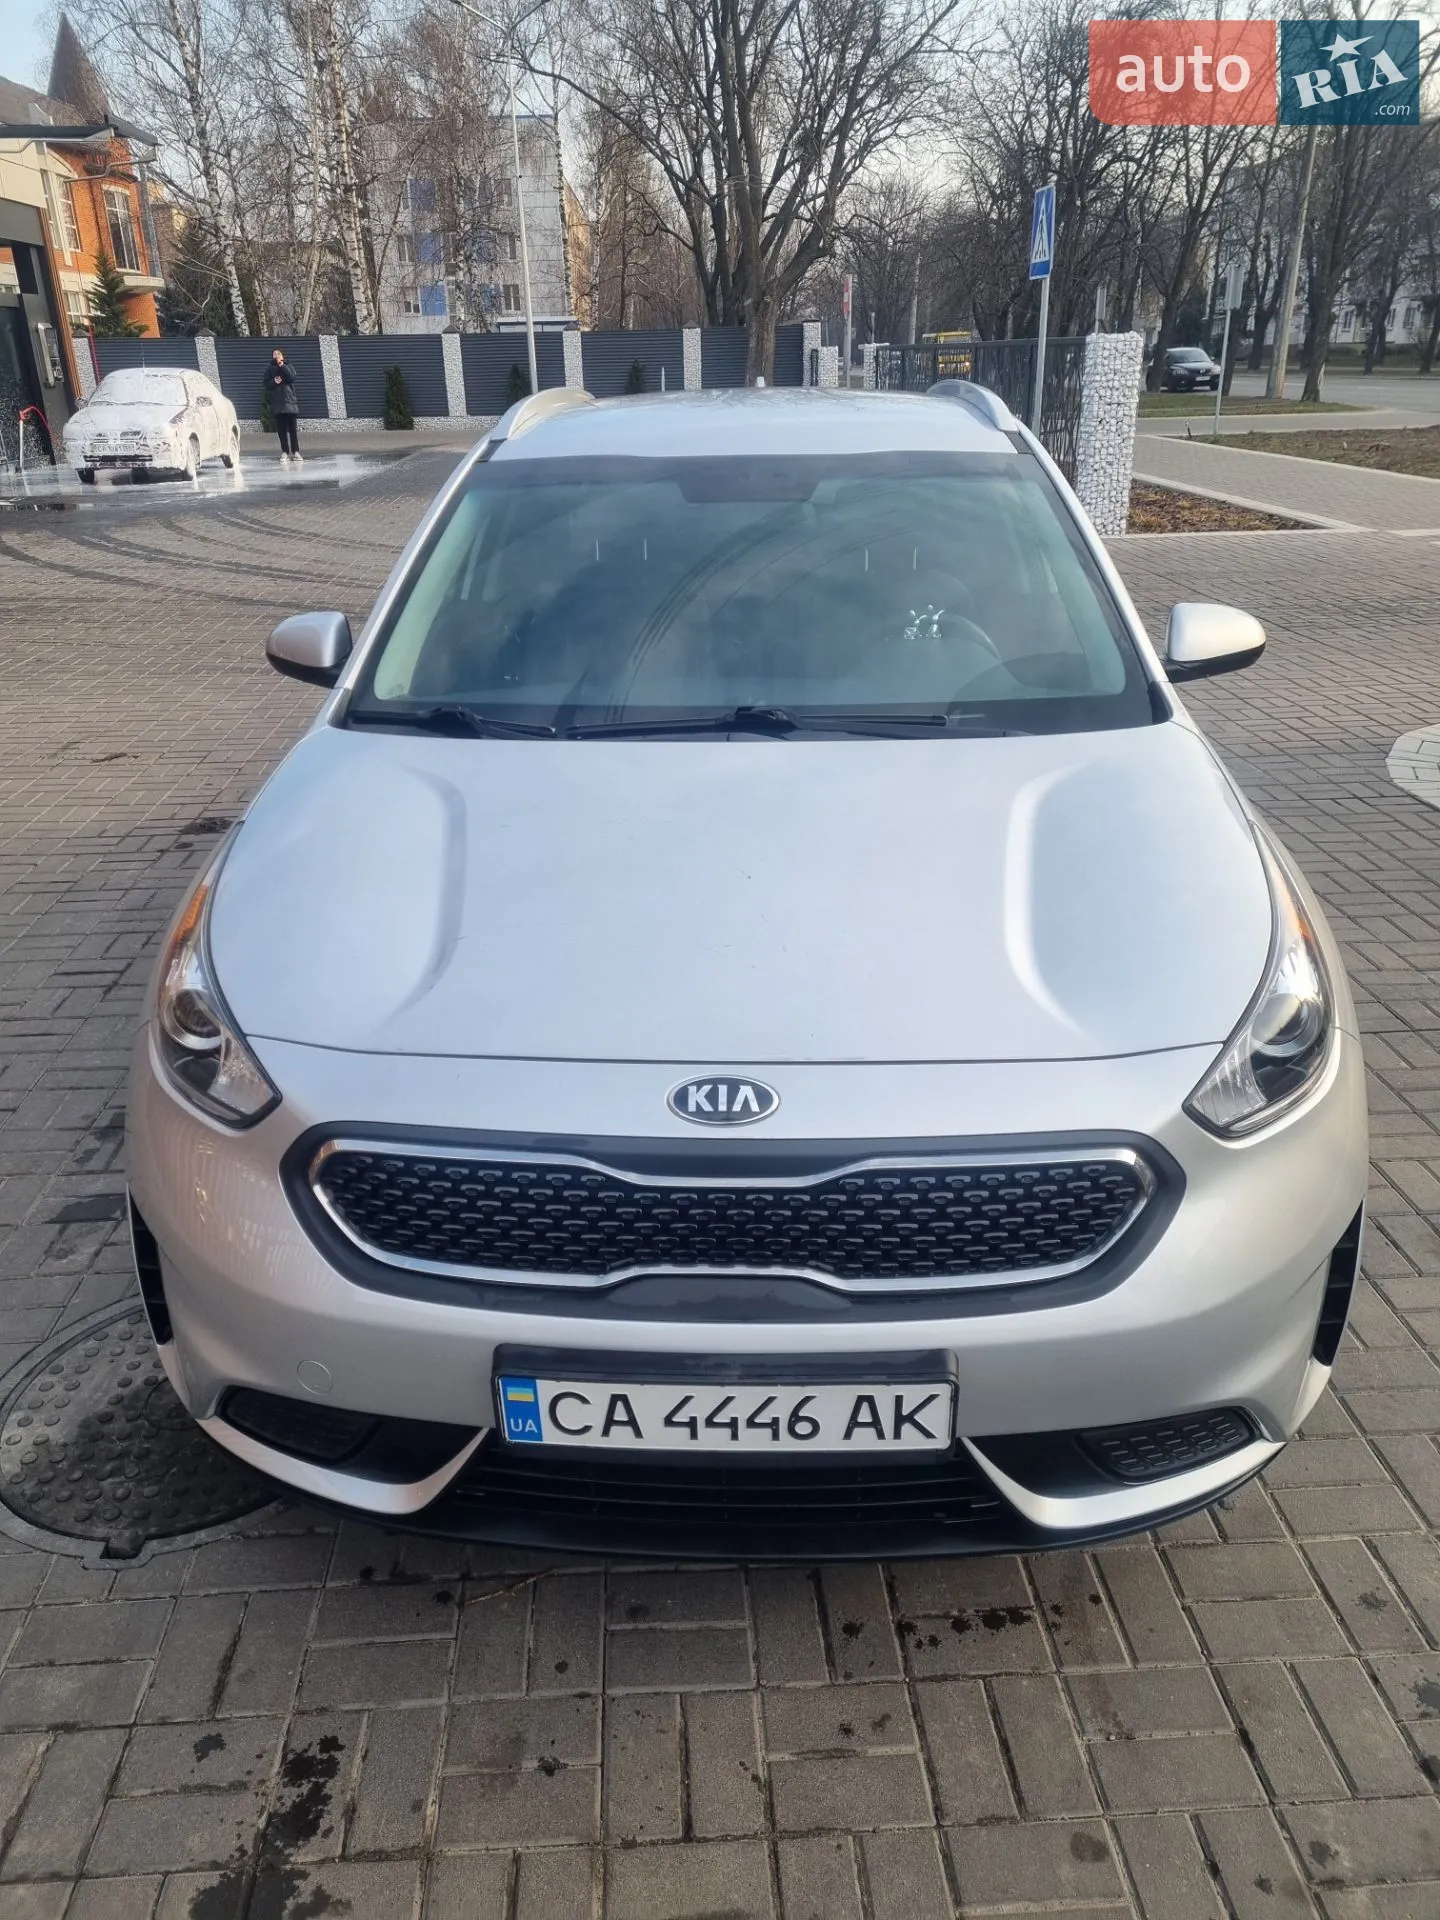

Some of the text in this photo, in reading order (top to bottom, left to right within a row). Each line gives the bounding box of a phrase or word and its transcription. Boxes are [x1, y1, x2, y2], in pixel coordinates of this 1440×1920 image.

[687, 1084, 760, 1112] KIA
[510, 1418, 538, 1433] UA
[548, 1391, 940, 1441] CA 4446 AK
